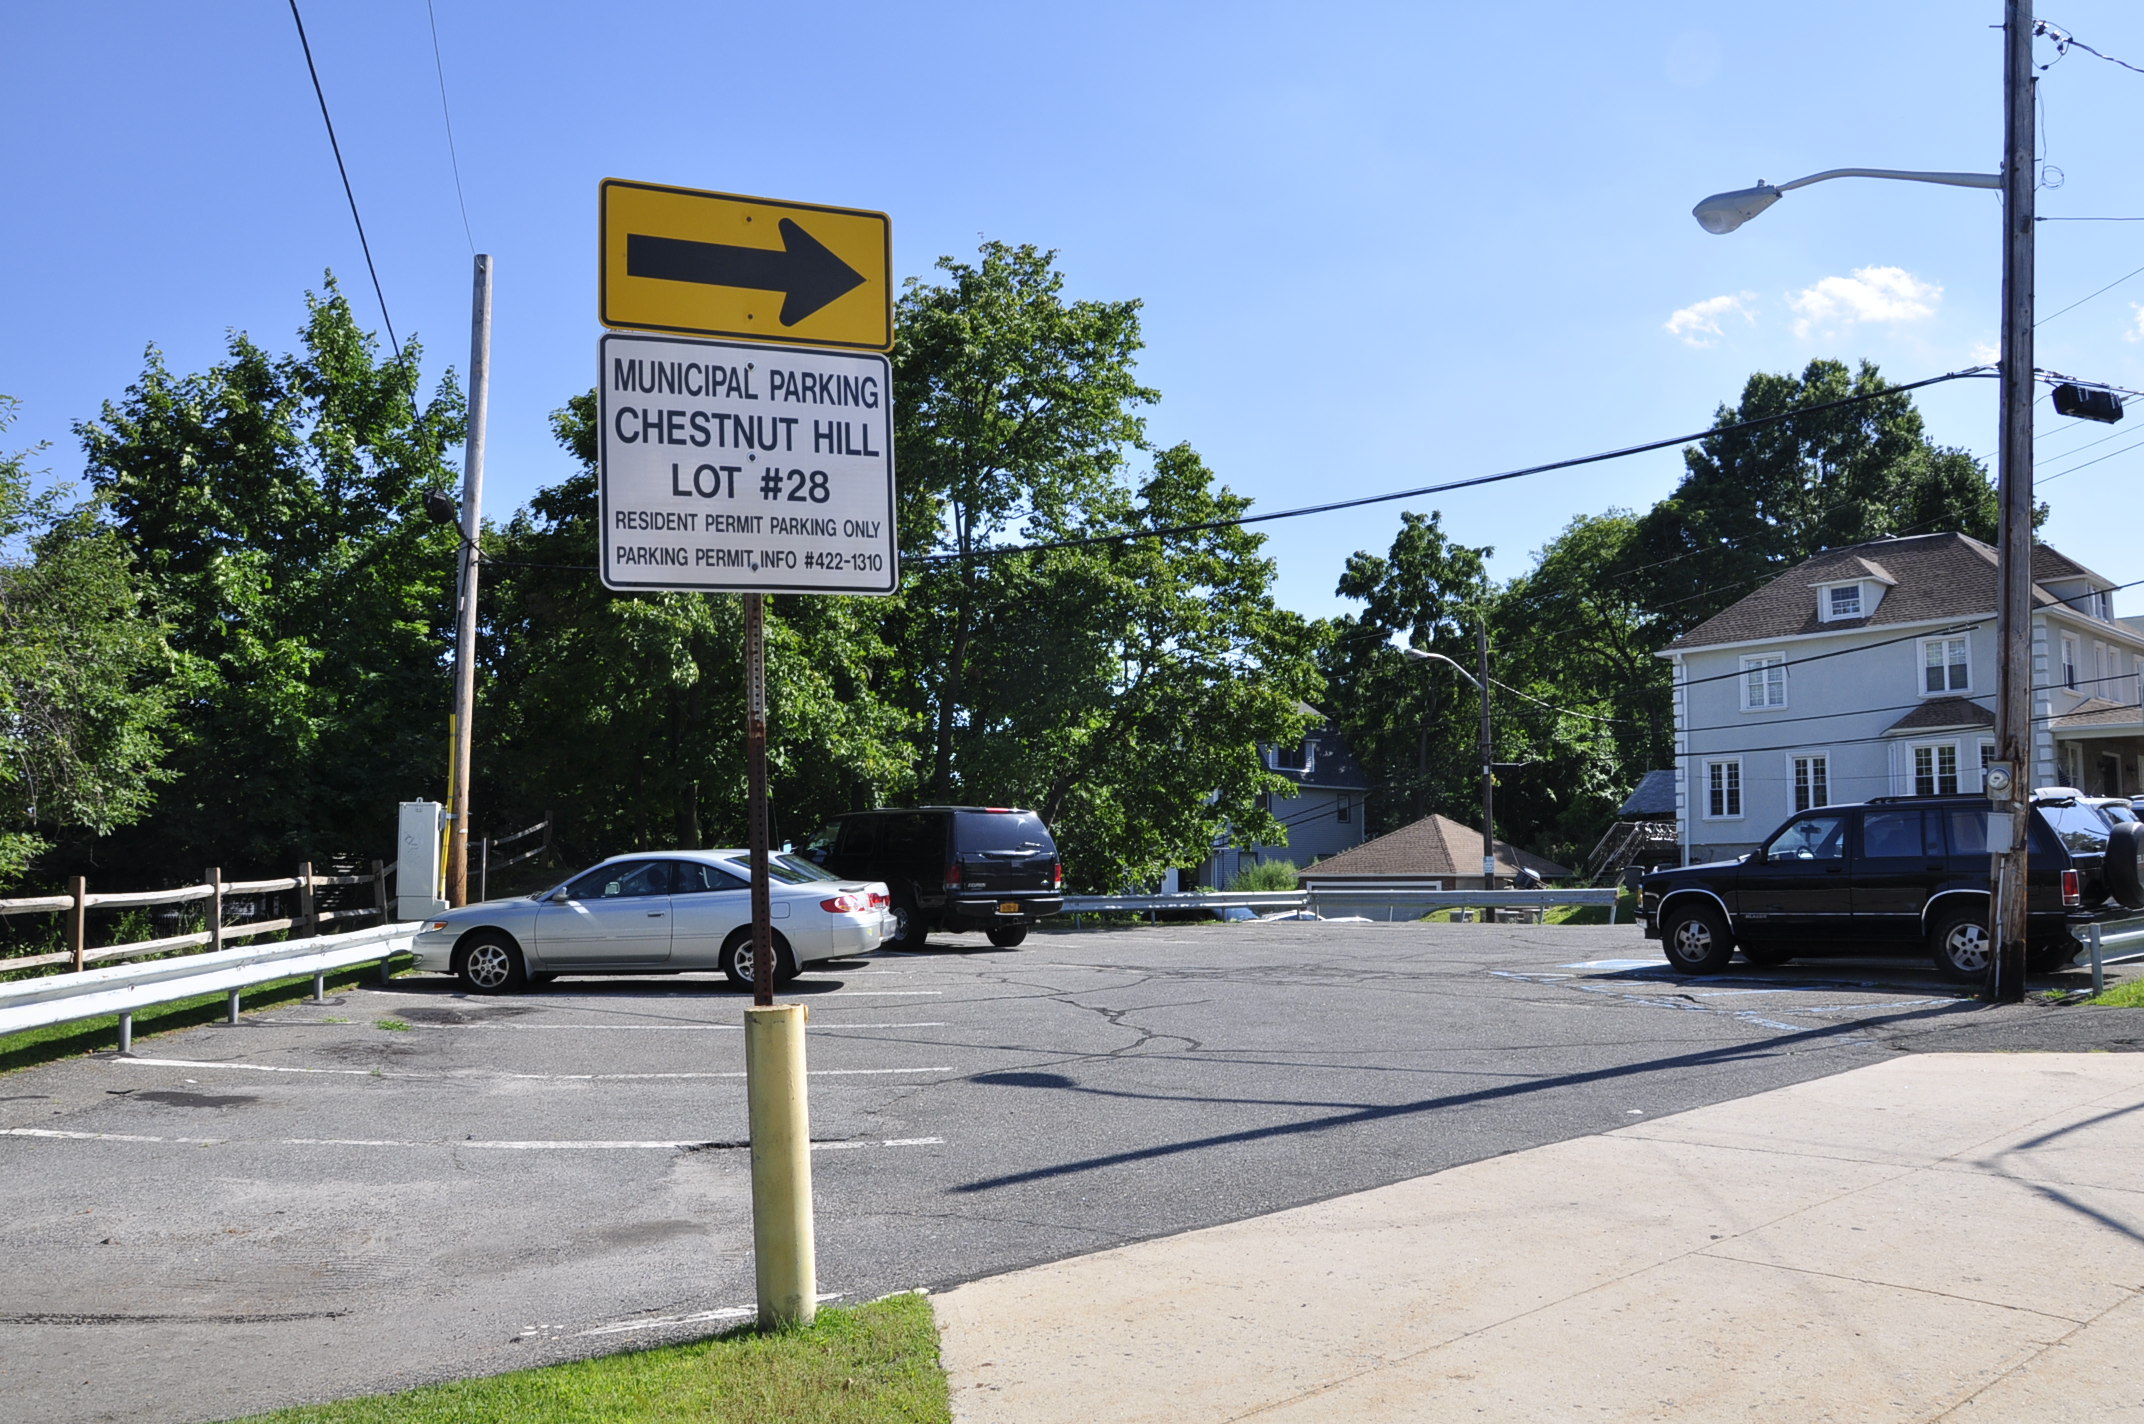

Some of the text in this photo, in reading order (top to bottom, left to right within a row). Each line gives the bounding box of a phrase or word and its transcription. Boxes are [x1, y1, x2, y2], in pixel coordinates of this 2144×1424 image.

[614, 357, 879, 409] MUNICIPAL PARKING
[614, 406, 880, 458] CHESTNUT HILL
[671, 462, 831, 504] LOT #28
[615, 510, 881, 539] RESIDENT PERMIT PARKING ONLY
[616, 545, 883, 572] PARKING PERMIT INFO #422-1310
